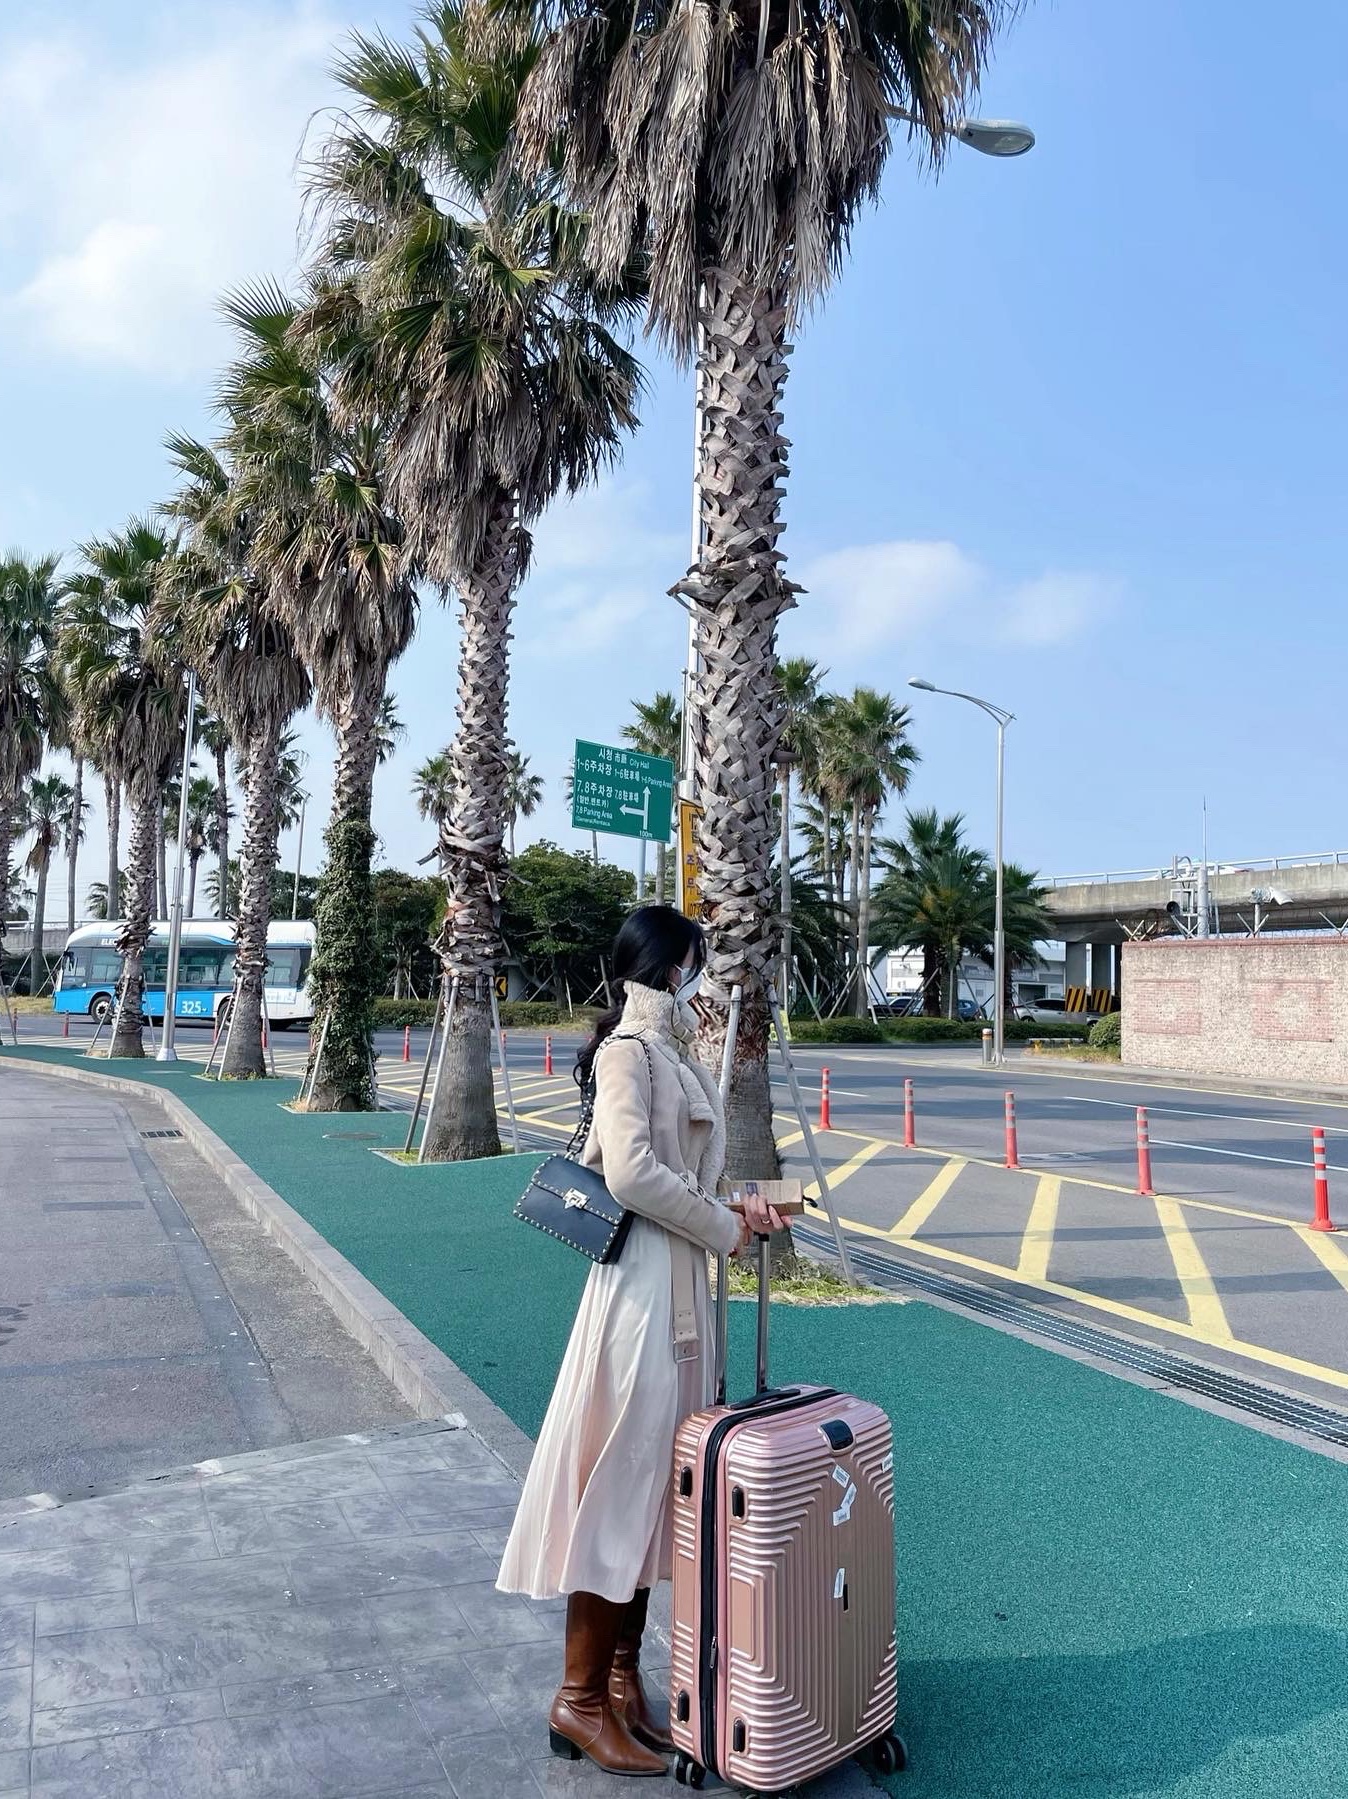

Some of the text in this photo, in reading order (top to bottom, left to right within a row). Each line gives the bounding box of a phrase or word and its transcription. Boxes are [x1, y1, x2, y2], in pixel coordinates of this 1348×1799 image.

[598, 747, 613, 760] 시청
[629, 758, 639, 769] City
[640, 760, 650, 769] Hall
[648, 776, 662, 788] Parking
[584, 806, 601, 819] Parking
[601, 810, 613, 819] Area
[639, 830, 653, 838] 100m
[181, 1000, 202, 1014] 325
